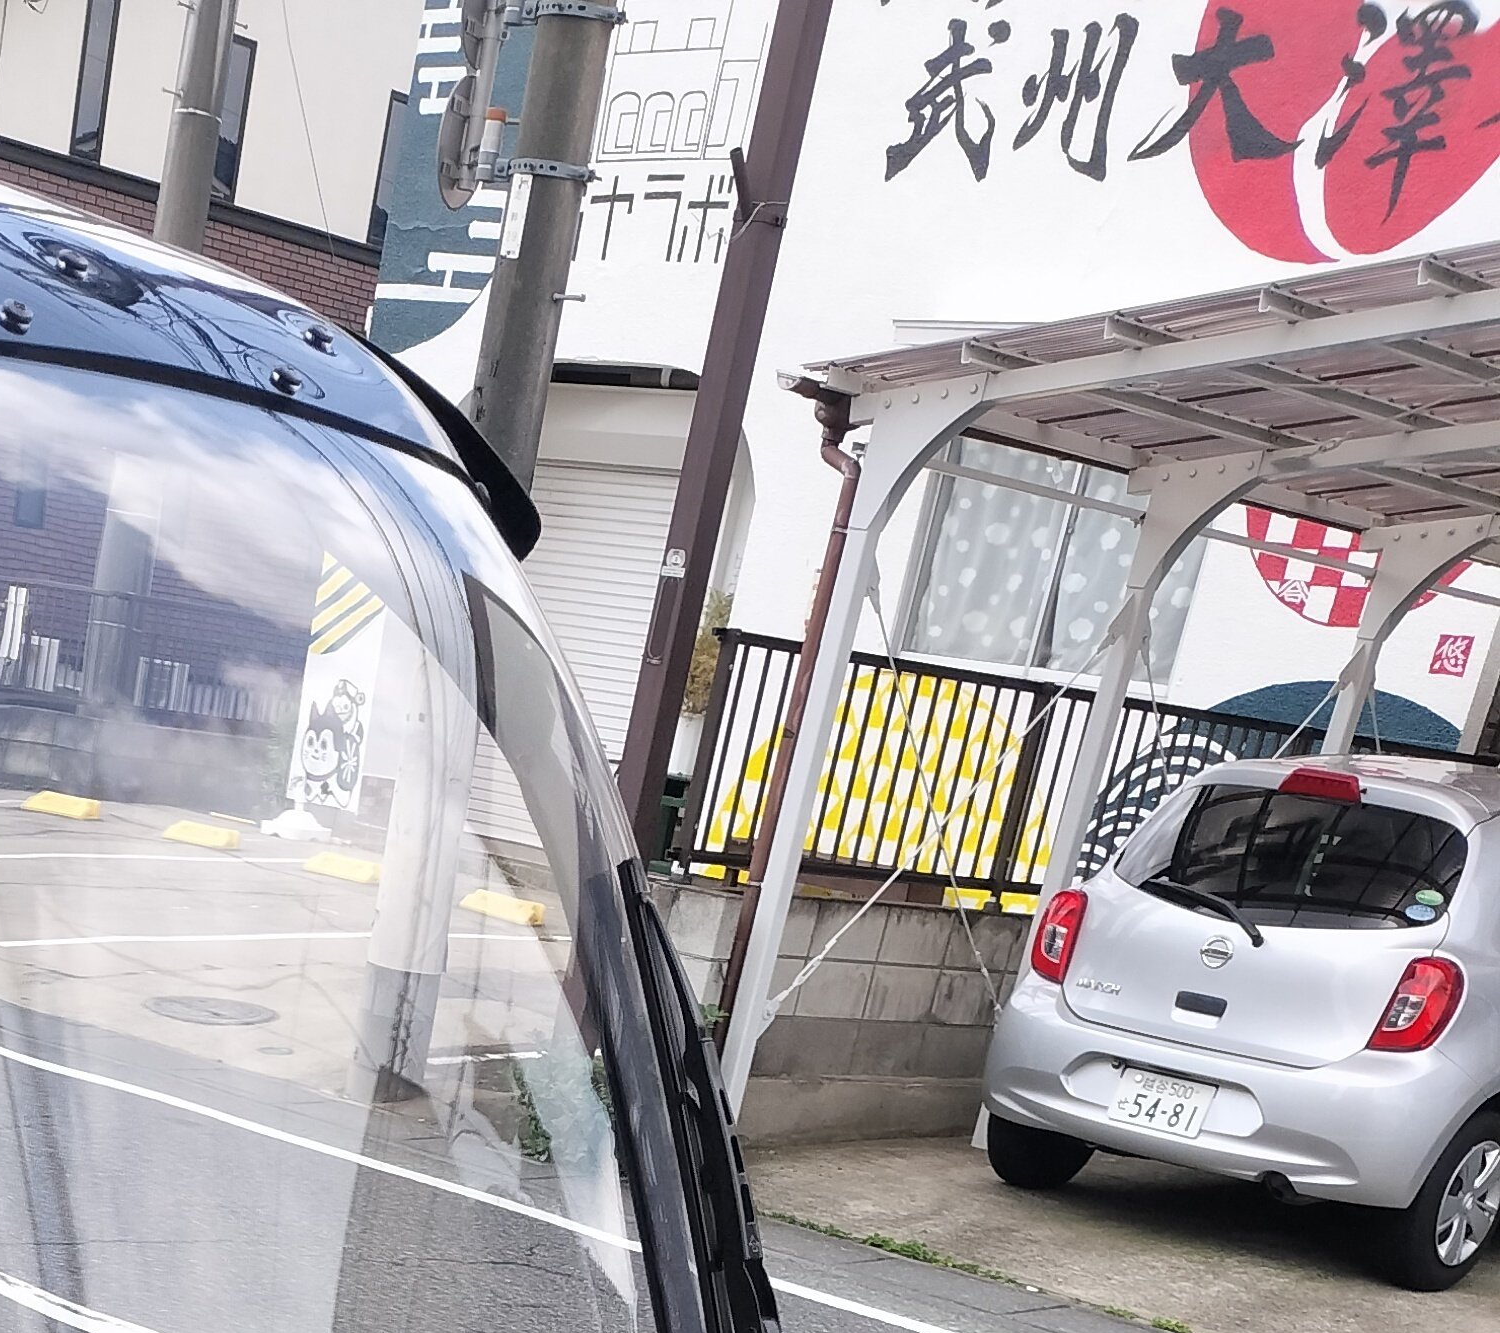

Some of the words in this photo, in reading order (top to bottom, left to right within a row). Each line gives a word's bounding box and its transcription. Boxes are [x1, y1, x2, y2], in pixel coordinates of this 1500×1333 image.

[884, 0, 1500, 226] 武州大澤
[1128, 1092, 1199, 1132] 54-81
